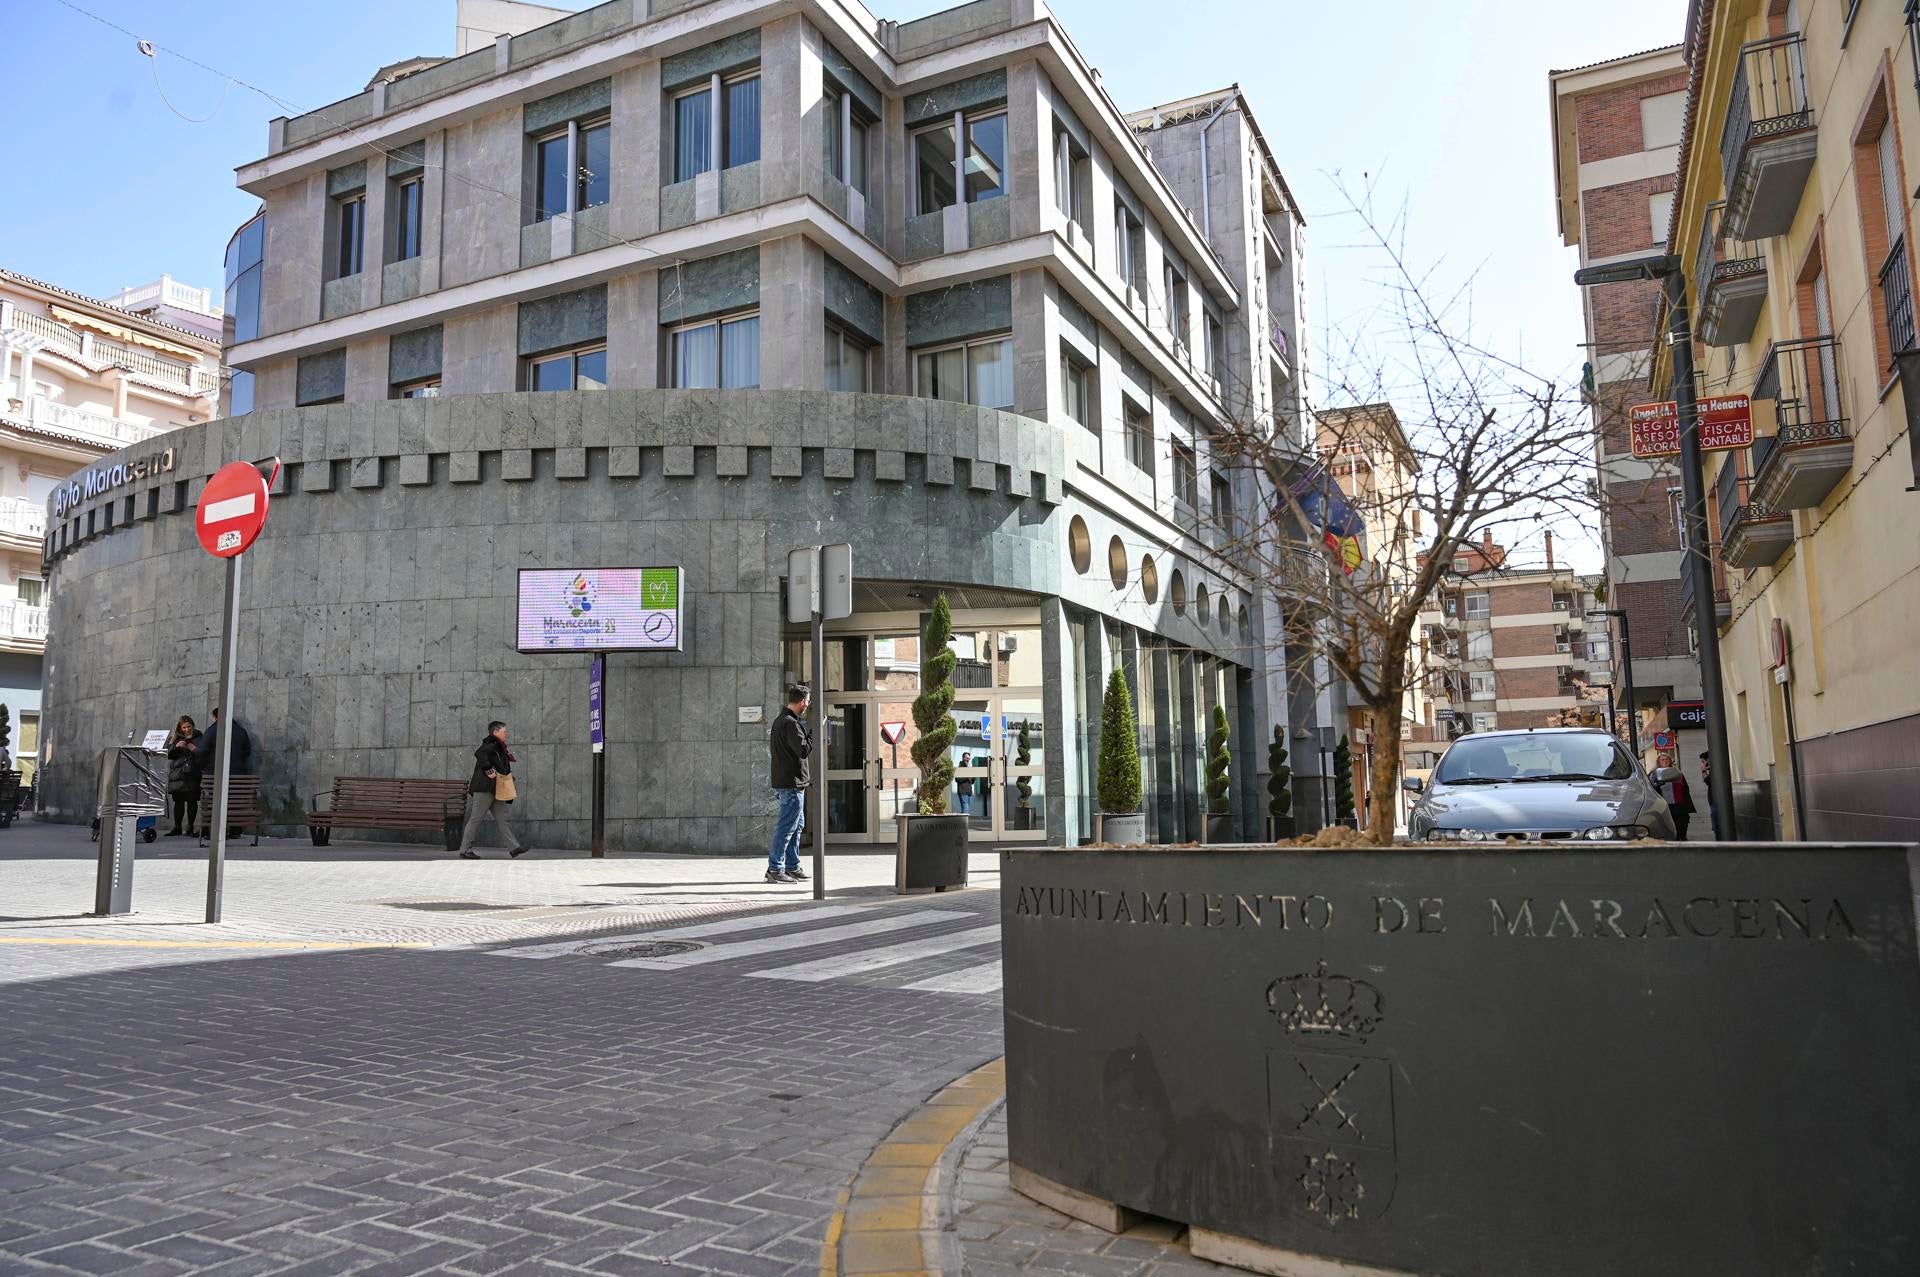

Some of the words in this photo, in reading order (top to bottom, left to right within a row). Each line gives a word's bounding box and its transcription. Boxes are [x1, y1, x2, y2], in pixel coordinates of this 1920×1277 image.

[1710, 399, 1748, 411] Henares
[1633, 416, 1704, 433] SEGURS
[1705, 422, 1750, 436] FISCAL
[1699, 432, 1750, 447] ONTABLE
[56, 481, 80, 517] Ayto
[84, 447, 174, 500] Maracena
[1016, 886, 1334, 931] AYUNTAMIENTO
[1372, 896, 1448, 935] DE
[1487, 897, 1862, 941] MARACENA
